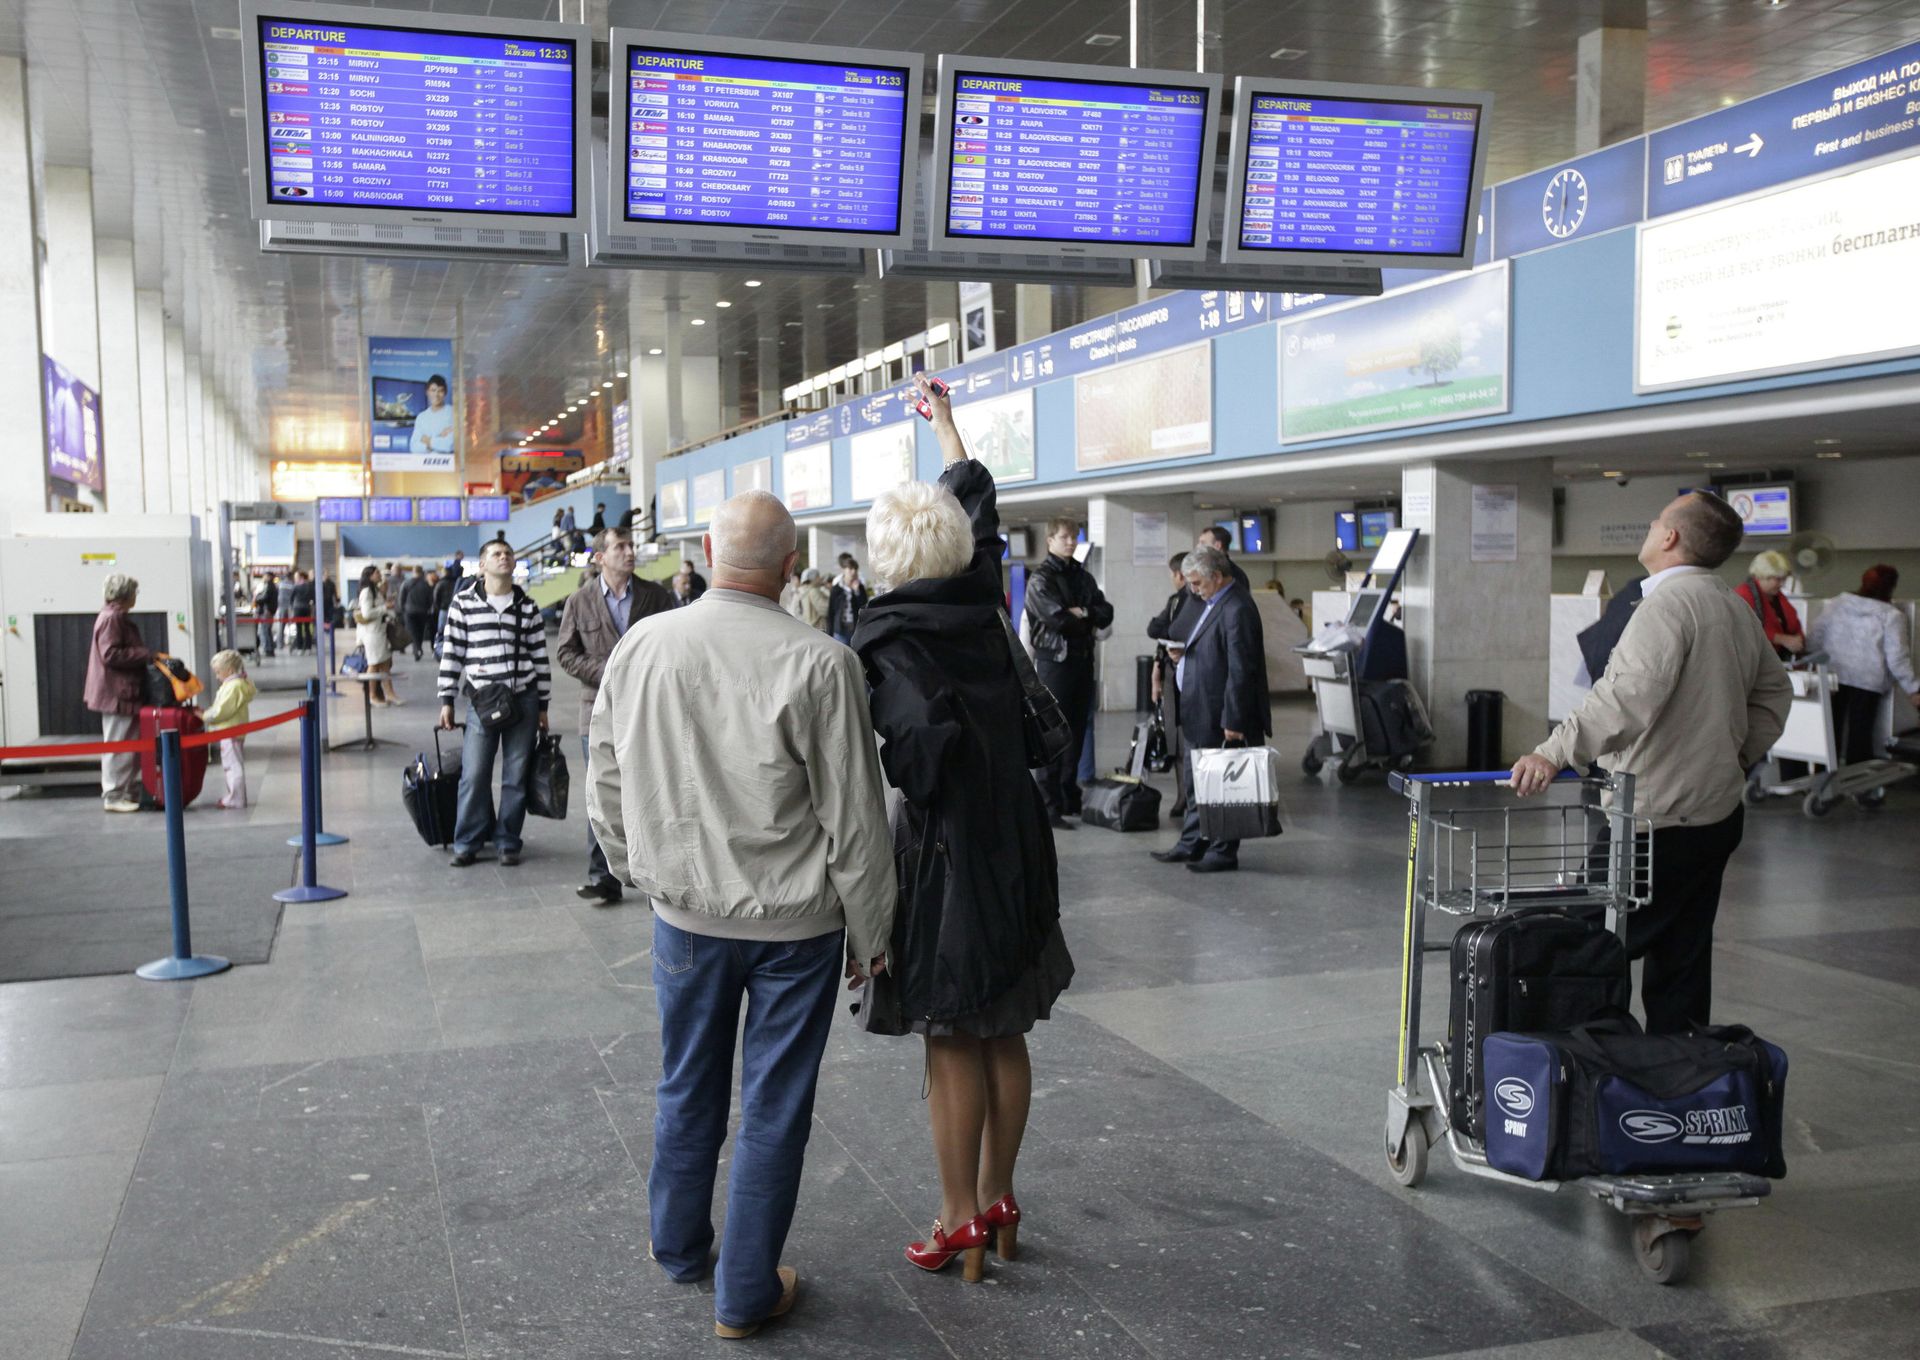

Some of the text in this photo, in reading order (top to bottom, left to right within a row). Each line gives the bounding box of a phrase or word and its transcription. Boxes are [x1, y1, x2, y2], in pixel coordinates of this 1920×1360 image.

[271, 27, 346, 42] DEPARTURE
[539, 49, 568, 59] 12:33
[349, 59, 379, 68] MIRNYJ
[638, 56, 704, 70] DEPARTURE
[350, 74, 379, 83] MIRNYJ
[876, 76, 901, 86] 12:33
[962, 80, 1022, 92] DEPARTURE
[1832, 75, 1877, 101] ВЫХОД
[1880, 69, 1898, 86] НА
[716, 88, 760, 96] PETERSBUR
[704, 100, 739, 108] VORKUTA
[1178, 95, 1200, 104] 12:33
[351, 105, 383, 113] ROSTOV
[1258, 100, 1312, 111] DEPARTURE
[1792, 102, 1841, 130] ПЕРВЫЙ
[1843, 99, 1854, 114] И
[1855, 83, 1906, 110] БИЗНЕС
[1021, 107, 1068, 116] VLADIVOSTOK
[1452, 111, 1473, 121] 12:33
[704, 114, 734, 122] SAMARA
[351, 119, 384, 127] ROSTOV
[704, 128, 760, 138] EKATERINBURG
[1020, 133, 1073, 142] BLAGOVESCHEN
[1814, 118, 1914, 156] First and business
[352, 134, 406, 143] KALININGRAD
[703, 142, 753, 151] KHABAROVSK
[352, 148, 413, 158] MAKHACHKALA
[1687, 142, 1728, 163] ТУАЛЕТЫ
[703, 156, 748, 164] KRASNODAR
[1018, 159, 1072, 168] BLAGOVESCHEN
[353, 162, 387, 171] SAMARA
[702, 169, 736, 177] GROZNYJ
[1017, 172, 1045, 180] ROSTOV
[353, 177, 391, 185] GROZNYJ
[702, 183, 751, 192] CHEBOKSARY
[1016, 185, 1058, 193] VOLGOGRAD
[354, 191, 404, 200] KRASNODAR
[702, 196, 732, 204] ROSTOV
[1199, 309, 1220, 331] 1-18
[1685, 1105, 1749, 1136] SPRINT
[1504, 1120, 1527, 1138] SPRINT
[1708, 1132, 1752, 1145] ATHLETIC
